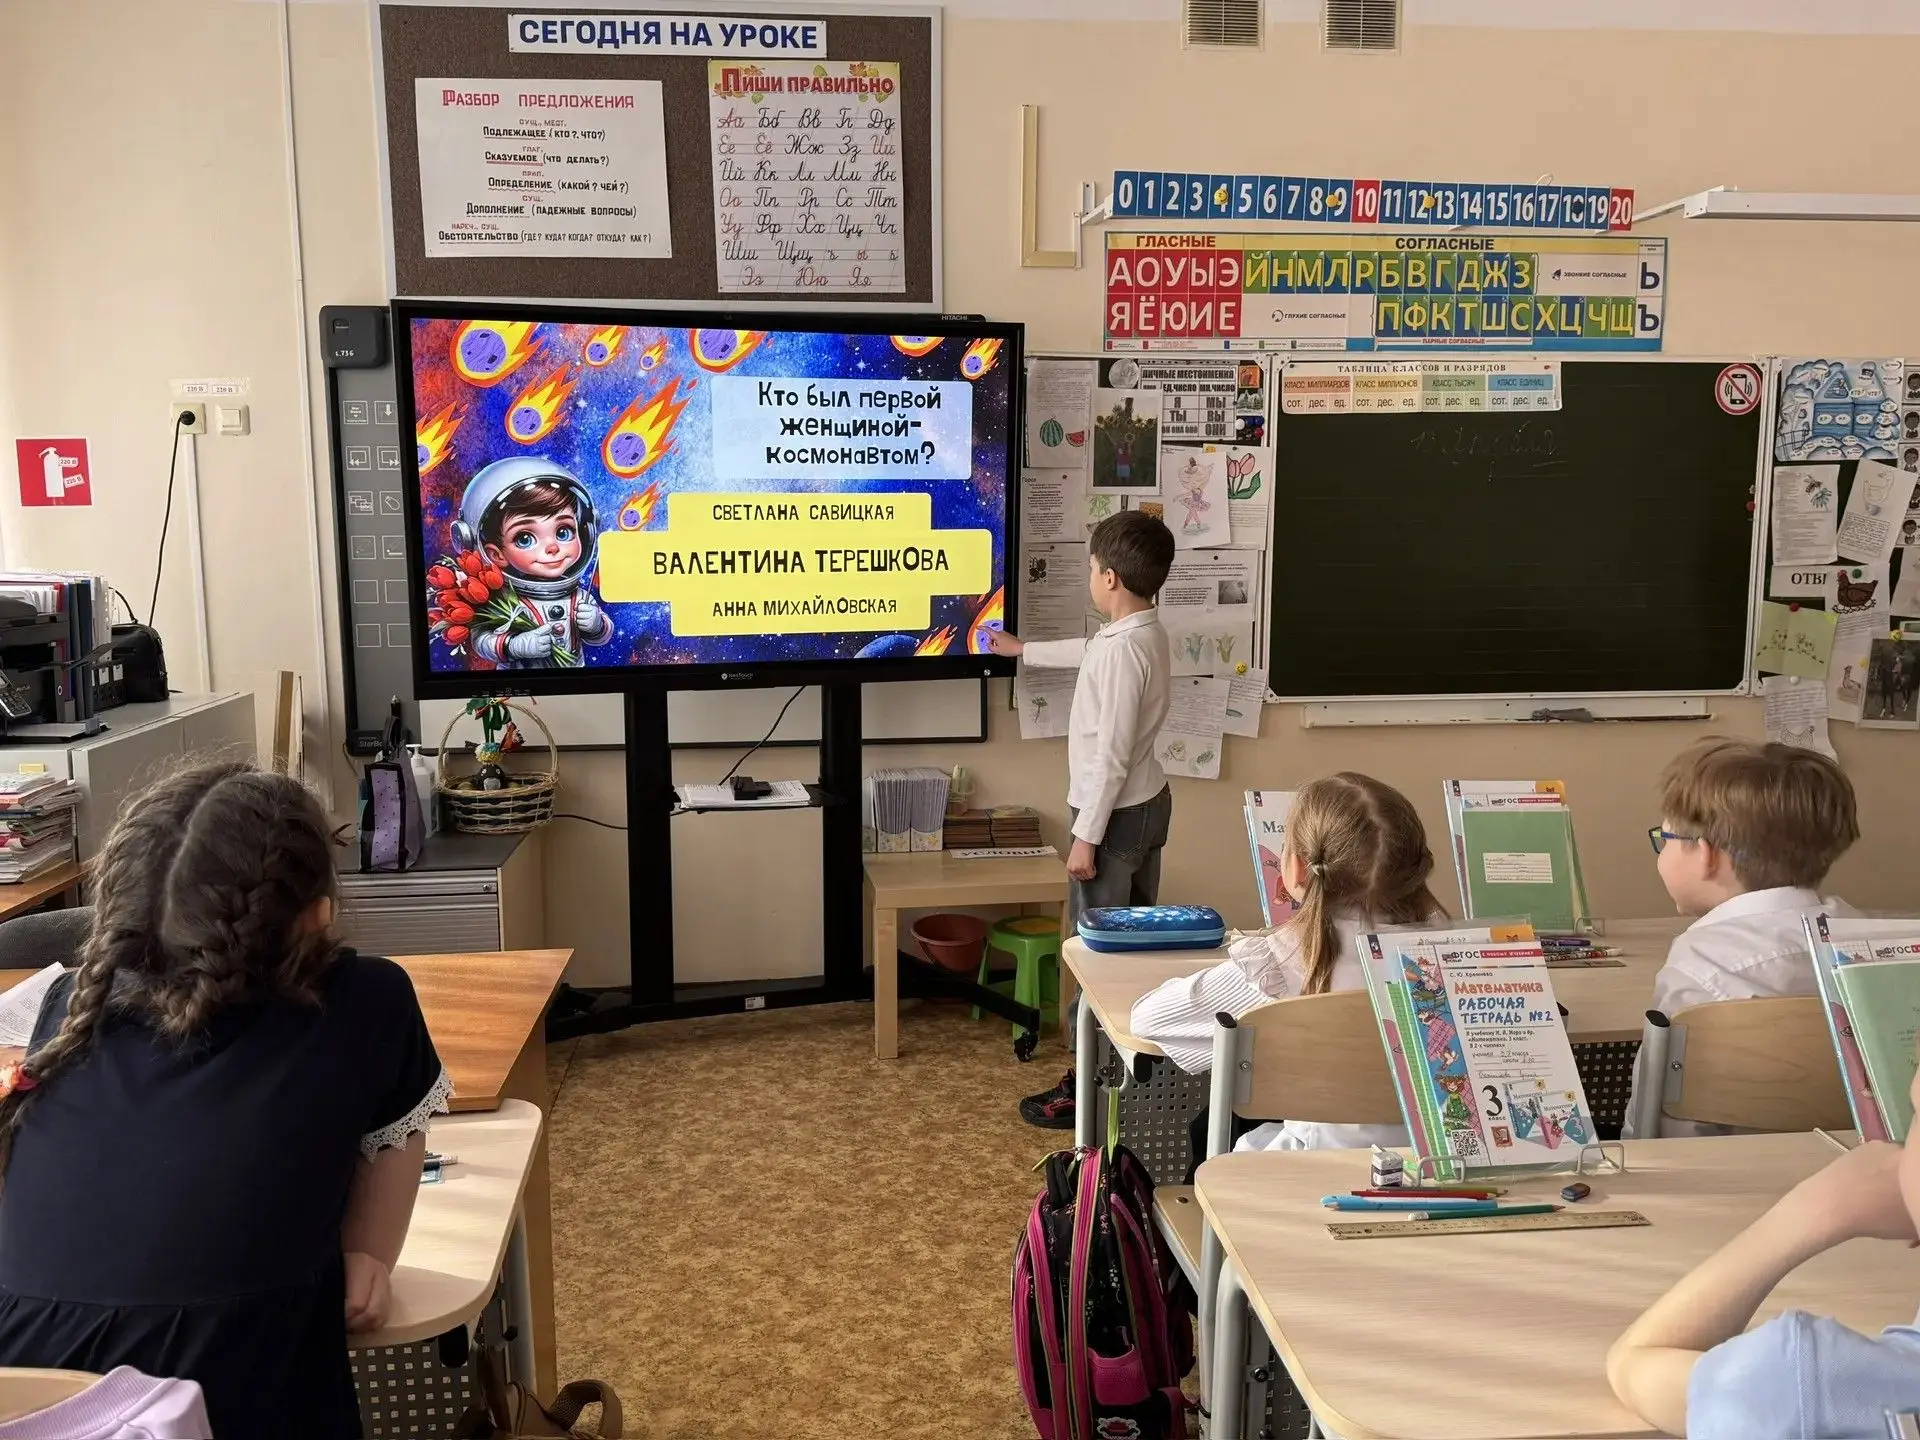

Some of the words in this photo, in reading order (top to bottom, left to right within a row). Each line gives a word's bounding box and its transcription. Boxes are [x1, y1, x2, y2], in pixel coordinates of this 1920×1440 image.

[519, 19, 661, 49] СЕГОДНЯ
[670, 21, 713, 47] НА
[718, 23, 818, 49] УРОКЕ
[787, 76, 895, 94] ПРАВИЛЬНО
[518, 94, 634, 109] ПРЕДЛОЖЕНИЯ
[717, 107, 744, 128] Аа
[759, 107, 785, 128] Бб
[799, 108, 821, 128] Вв
[868, 109, 895, 135] Дд
[719, 135, 736, 155] Ее
[755, 132, 772, 155] Ёё
[784, 135, 824, 155] Жж
[839, 135, 861, 162] Зз
[871, 135, 895, 155] Ии
[720, 158, 745, 181] Йй
[754, 161, 778, 181] Кк
[824, 161, 861, 181] Мм
[872, 160, 896, 181] Нн
[720, 188, 742, 207] Оо
[754, 188, 779, 207] Пп
[798, 188, 819, 214] Рр
[836, 188, 852, 207] Сс
[865, 188, 897, 207] Тт
[1118, 179, 1133, 209] 0
[1144, 180, 1155, 209] 1
[1166, 181, 1180, 211] 2
[1189, 181, 1203, 211] 3
[1238, 183, 1252, 213] 5
[1263, 184, 1276, 213] 6
[1287, 185, 1300, 214] 7
[1310, 186, 1323, 216] 8
[1333, 187, 1347, 216] 9
[1356, 187, 1376, 218] 10
[1382, 188, 1401, 218] 11
[1408, 190, 1429, 218] 12
[1434, 190, 1454, 219] 13
[1460, 192, 1482, 220] 14
[1486, 192, 1508, 221] 15
[1513, 192, 1534, 222] 16
[1539, 193, 1559, 221] 17
[1588, 195, 1608, 223] 19
[1610, 196, 1631, 225] 20
[721, 214, 744, 239] Уу
[756, 214, 782, 240] Фф
[797, 214, 825, 234] Хх
[836, 215, 863, 238] Цц
[875, 215, 896, 234] Чч
[1136, 235, 1216, 248] ГЛАСНЫЕ
[1395, 237, 1495, 251] СОГЛАСНЫЕ
[723, 240, 759, 260] Шш
[775, 240, 813, 264] Щщ
[857, 250, 868, 260] ы
[742, 267, 763, 286] Ээ
[795, 267, 828, 286] Юю
[849, 266, 871, 286] Яя
[1640, 262, 1660, 289] Ь
[1638, 304, 1660, 331] Ъ
[1142, 370, 1176, 378] ЛИЧНЫЕ
[1177, 370, 1234, 379] МЕСТОИМЕНИЯ
[1392, 365, 1439, 373] КЛАССОВ
[758, 381, 799, 406] Кто
[807, 383, 851, 407] был
[859, 386, 941, 413] первой
[1174, 397, 1181, 408] Я
[1206, 397, 1226, 408] МЫ
[1287, 400, 1303, 408] сот.
[1309, 400, 1326, 408] дес.
[1356, 399, 1372, 407] сот.
[1377, 399, 1395, 407] дес.
[1402, 398, 1416, 407] ед.
[1426, 397, 1440, 406] сот.
[1445, 398, 1462, 406] дес.
[1492, 397, 1507, 405] сот.
[1513, 397, 1530, 406] дес.
[1169, 410, 1186, 422] ТЫ
[1207, 410, 1225, 422] ВЫ
[780, 413, 922, 438] женщиной-
[1205, 424, 1226, 435] ОНИ
[766, 440, 935, 465] космонавтом?
[712, 504, 799, 521] СВЕТЛАНА
[809, 503, 894, 522] САВИЦКАЯ
[653, 550, 806, 575] ВАЛЕНТИНА
[815, 546, 949, 572] ТЕРЕШКОВА
[1791, 572, 1827, 585] ОТВ
[712, 601, 757, 617] АННА
[764, 595, 897, 616] МИХАЙЛОВСКАЯ
[1451, 951, 1479, 959] ФГОС
[1455, 982, 1543, 995] Математика
[1459, 997, 1525, 1010] РАБОЧАЯ
[1461, 1012, 1522, 1025] ТЕТРАДЬ
[1482, 1085, 1503, 1116] 3
